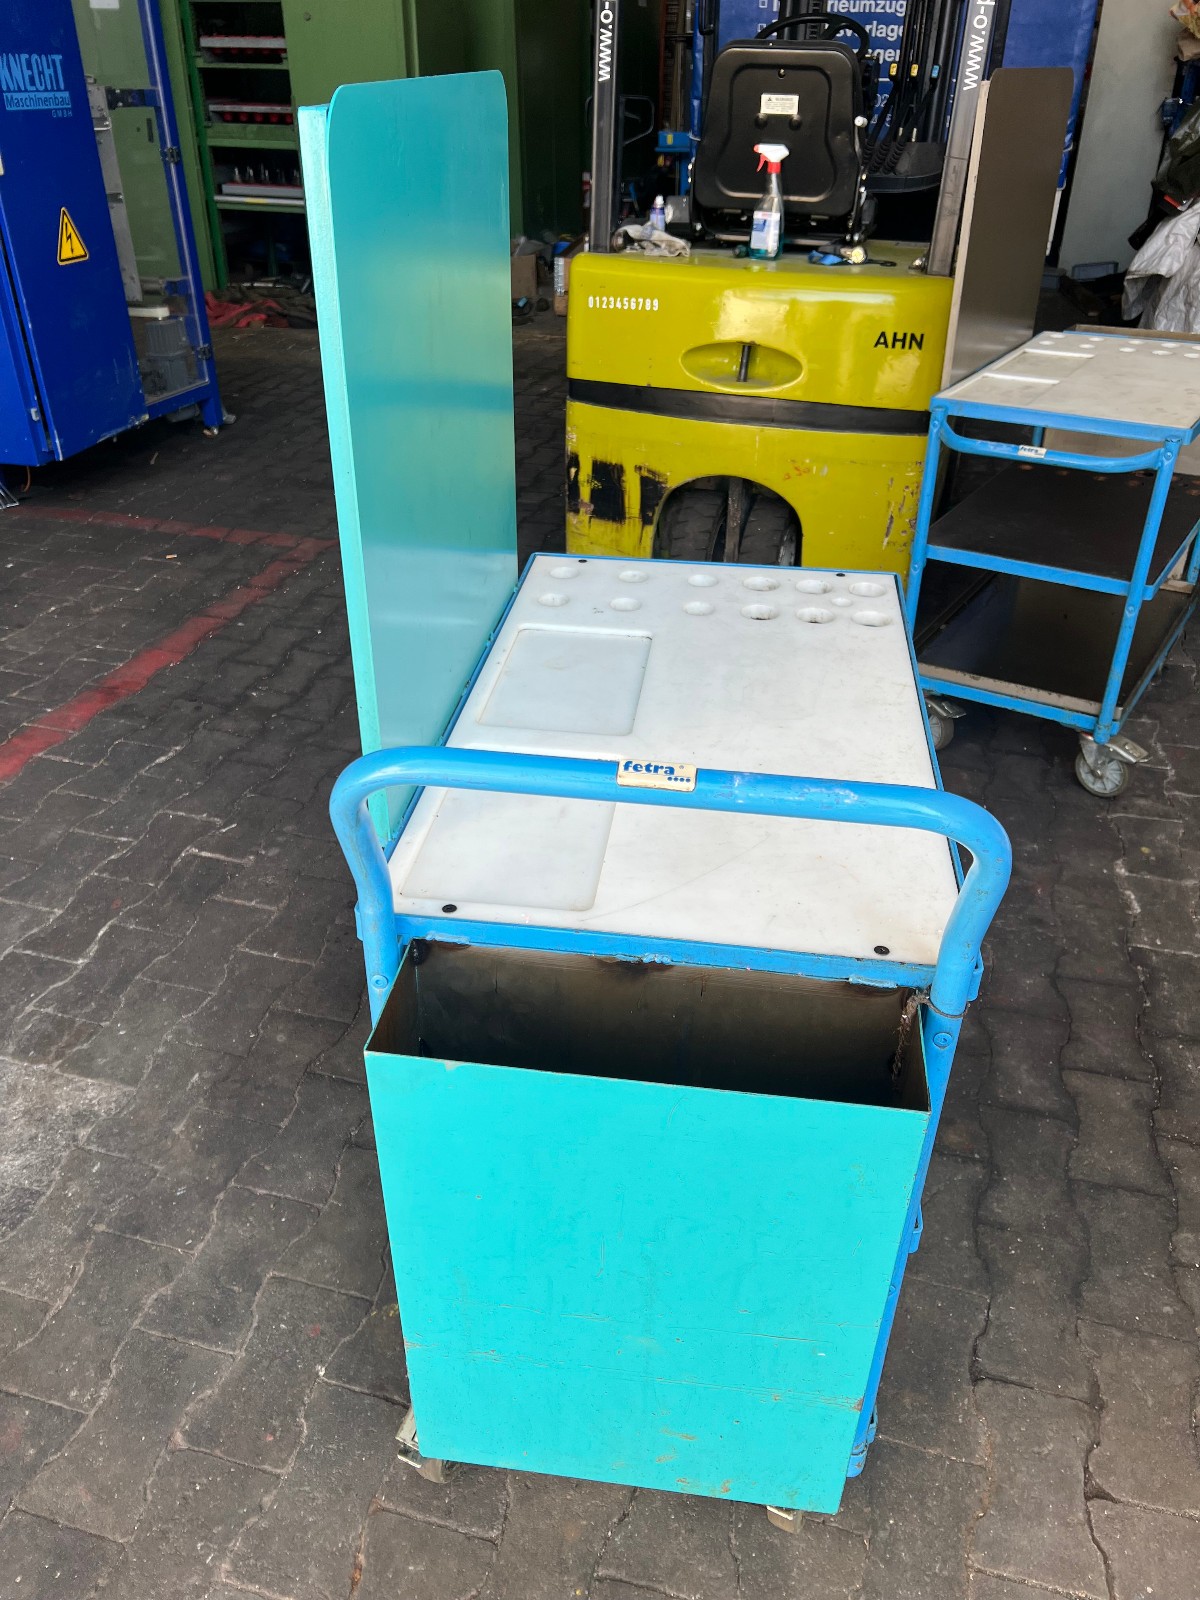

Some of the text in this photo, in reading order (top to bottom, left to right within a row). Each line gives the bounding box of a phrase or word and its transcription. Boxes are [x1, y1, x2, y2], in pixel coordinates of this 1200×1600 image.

[0, 53, 65, 91] KNECHT
[5, 92, 71, 110] Maschinenbau
[588, 295, 659, 311] 0123456789
[873, 331, 925, 351] AHN
[623, 760, 675, 775] fetra
